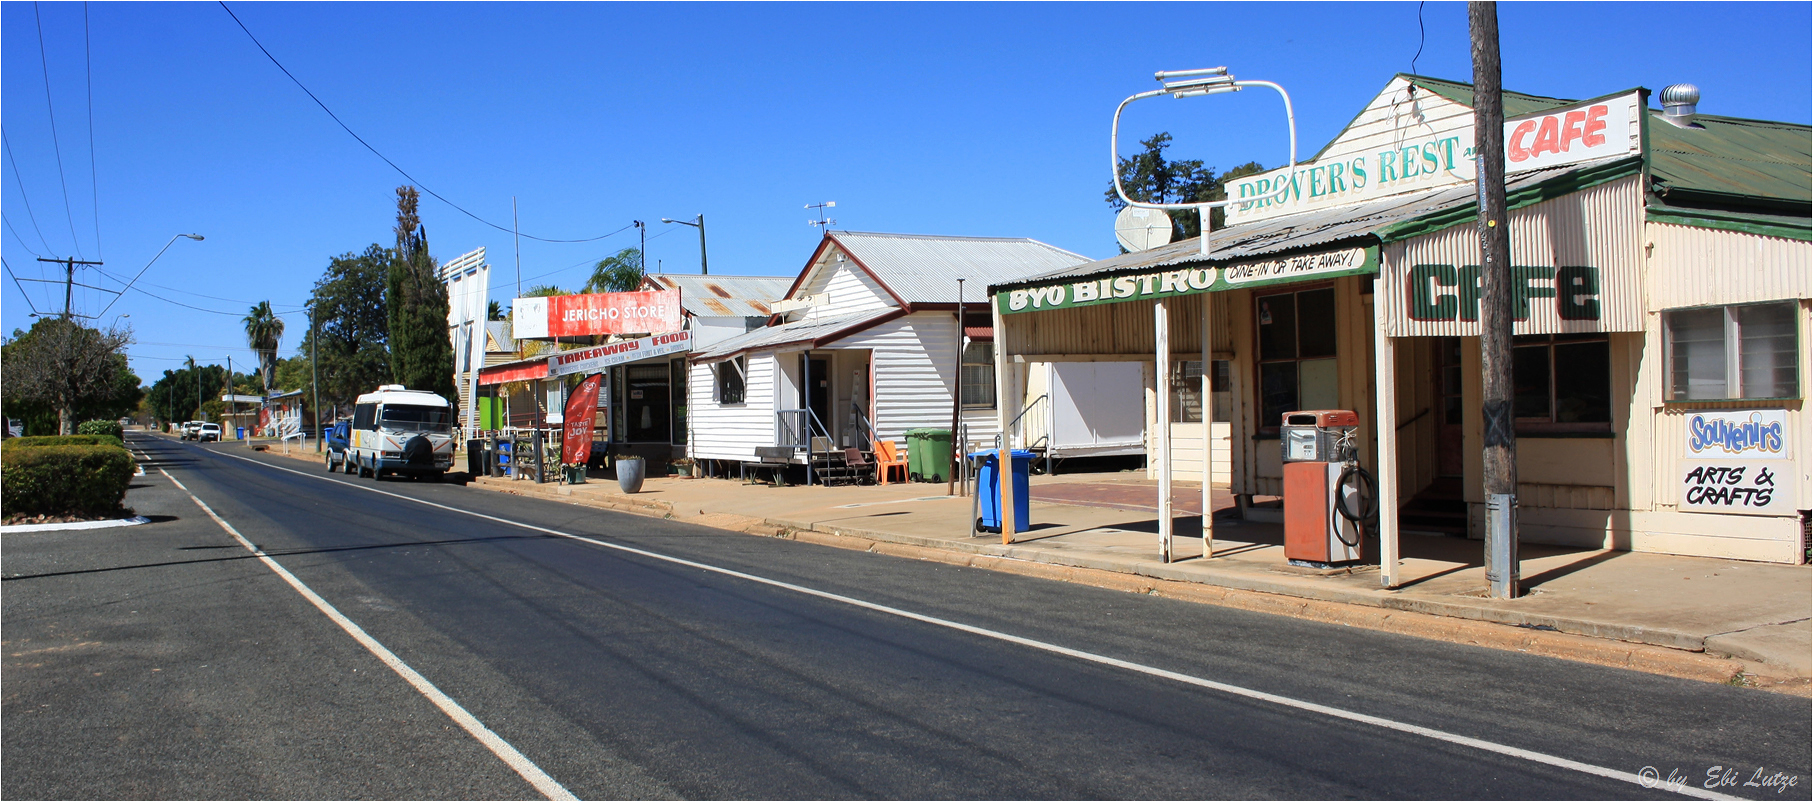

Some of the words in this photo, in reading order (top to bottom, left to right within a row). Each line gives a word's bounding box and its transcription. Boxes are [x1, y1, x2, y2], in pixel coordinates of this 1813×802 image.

[1507, 103, 1610, 163] CAFE
[1237, 156, 1369, 215] DROVER'S
[1378, 135, 1462, 184] REST
[1008, 285, 1066, 312] BYO
[1071, 266, 1218, 304] BISTRO
[1229, 262, 1270, 280] DINE-IN
[1272, 260, 1287, 275] OR
[1290, 255, 1315, 272] TAKE
[1317, 247, 1359, 270] AWAY!
[562, 307, 619, 322] JERICHO
[624, 305, 665, 319] STORE
[556, 340, 639, 366] TAKEAWAY
[652, 331, 689, 347] FOOD
[569, 427, 588, 437] JOY
[1689, 412, 1783, 454] Souvenirs
[1684, 466, 1746, 485] ARTS
[1754, 467, 1775, 487] &
[1686, 486, 1774, 507] CRAFTS
